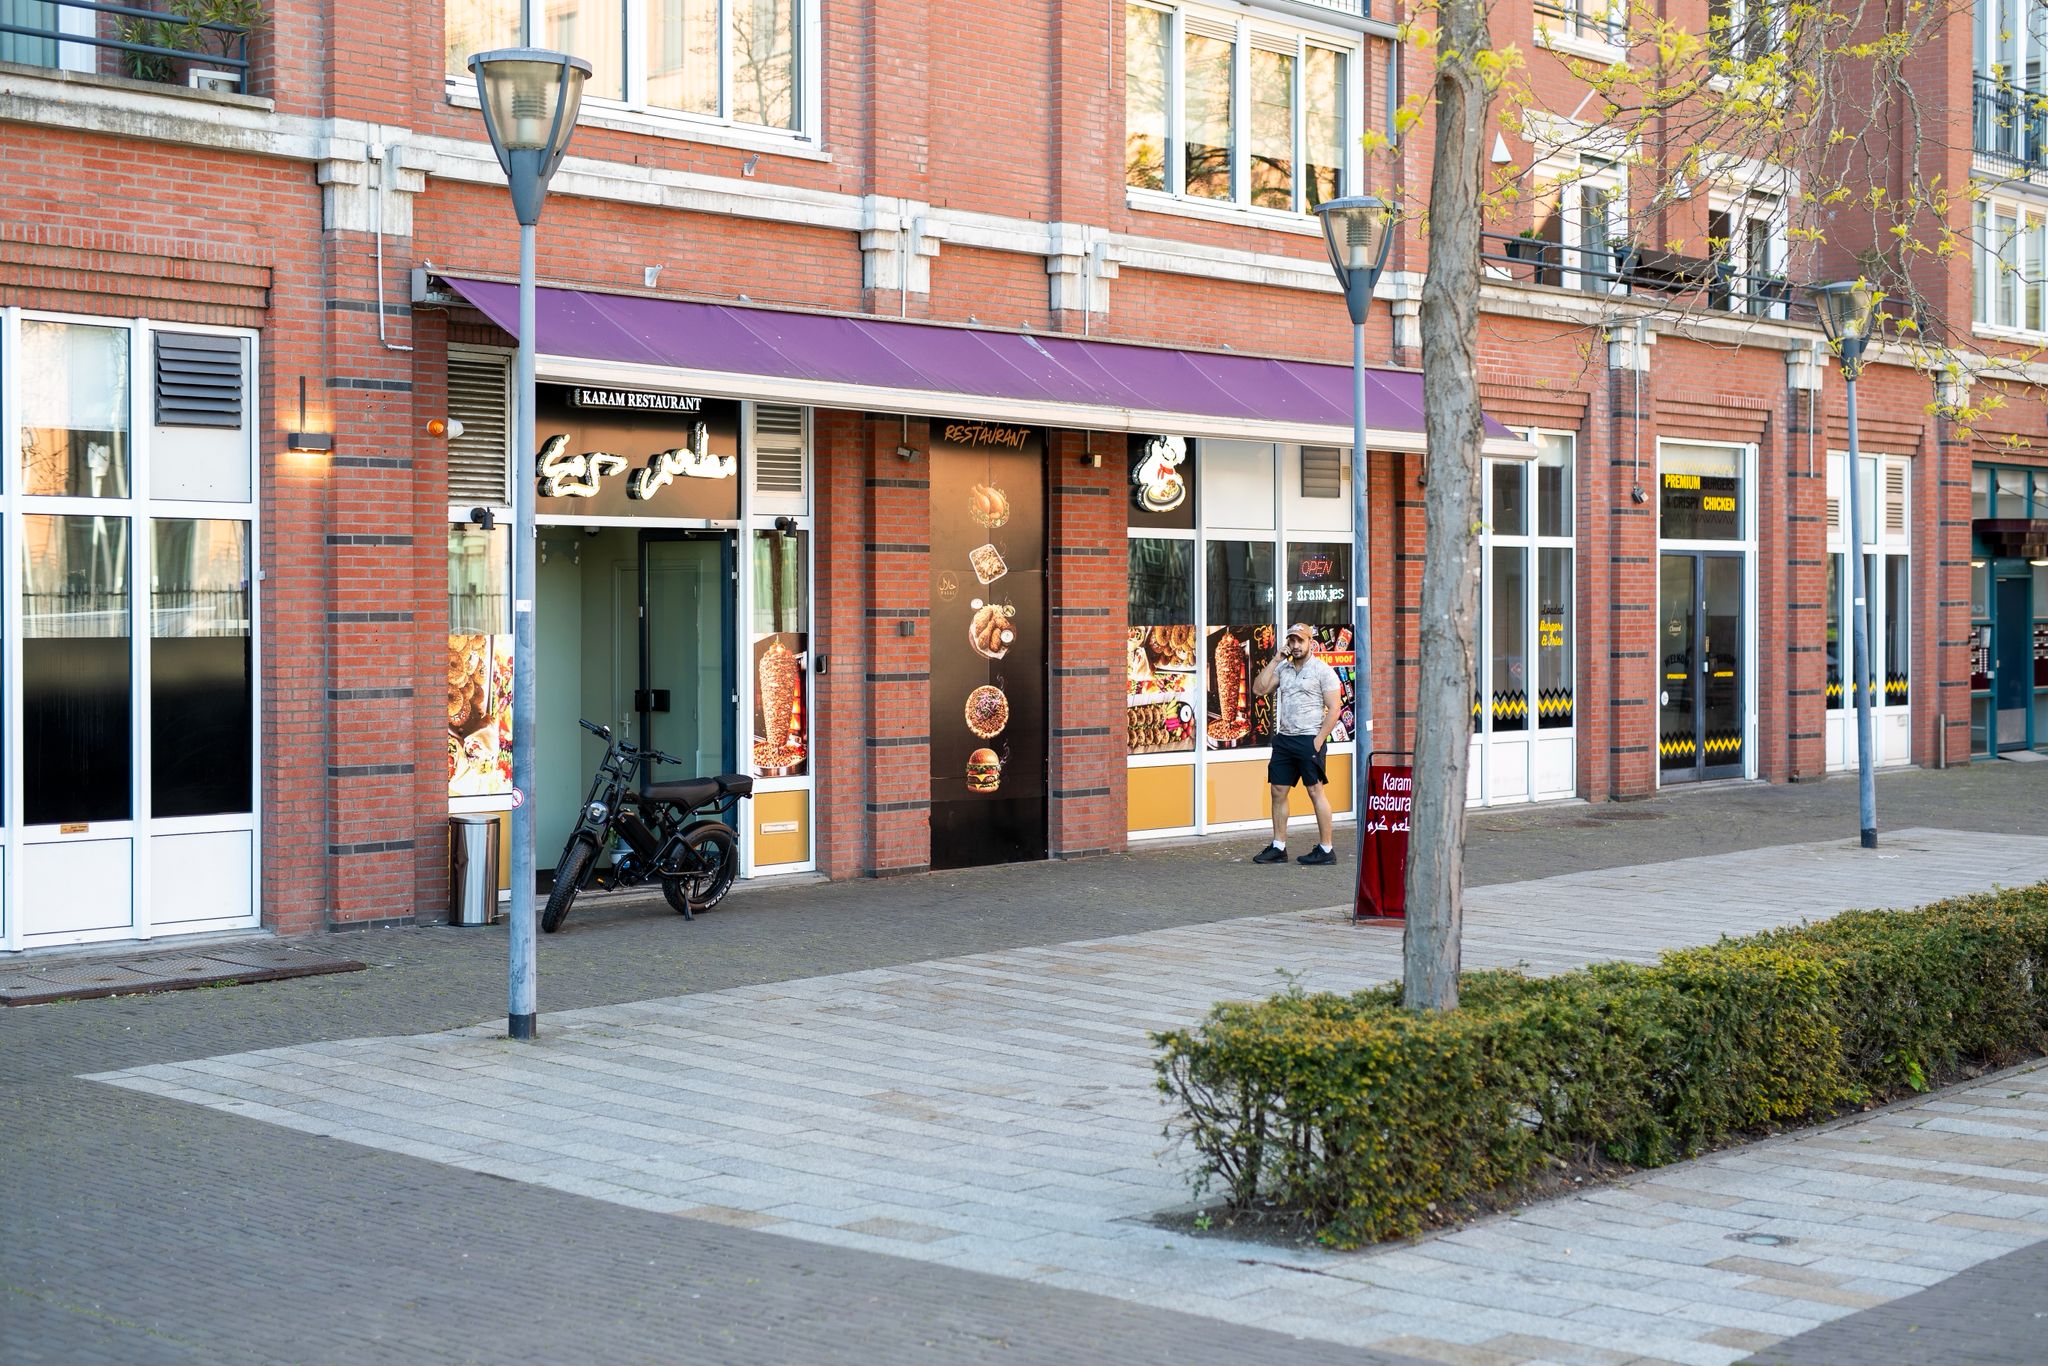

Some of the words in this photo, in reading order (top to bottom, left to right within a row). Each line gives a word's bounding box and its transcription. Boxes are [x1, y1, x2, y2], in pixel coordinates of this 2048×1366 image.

[582, 391, 626, 407] KARAM
[628, 393, 702, 411] RESTAURANT
[945, 425, 1031, 451] RESTAURANT
[1665, 475, 1700, 489] PREMIUM
[1703, 476, 1735, 491] BURGERS
[1673, 496, 1700, 509] CRISPY
[1703, 496, 1736, 512] CHICKEN
[1302, 561, 1333, 575] OPEN
[1297, 585, 1344, 602] drankjes
[1335, 655, 1354, 664] voor
[1382, 772, 1412, 791] Karam
[1369, 793, 1412, 812] restaura
